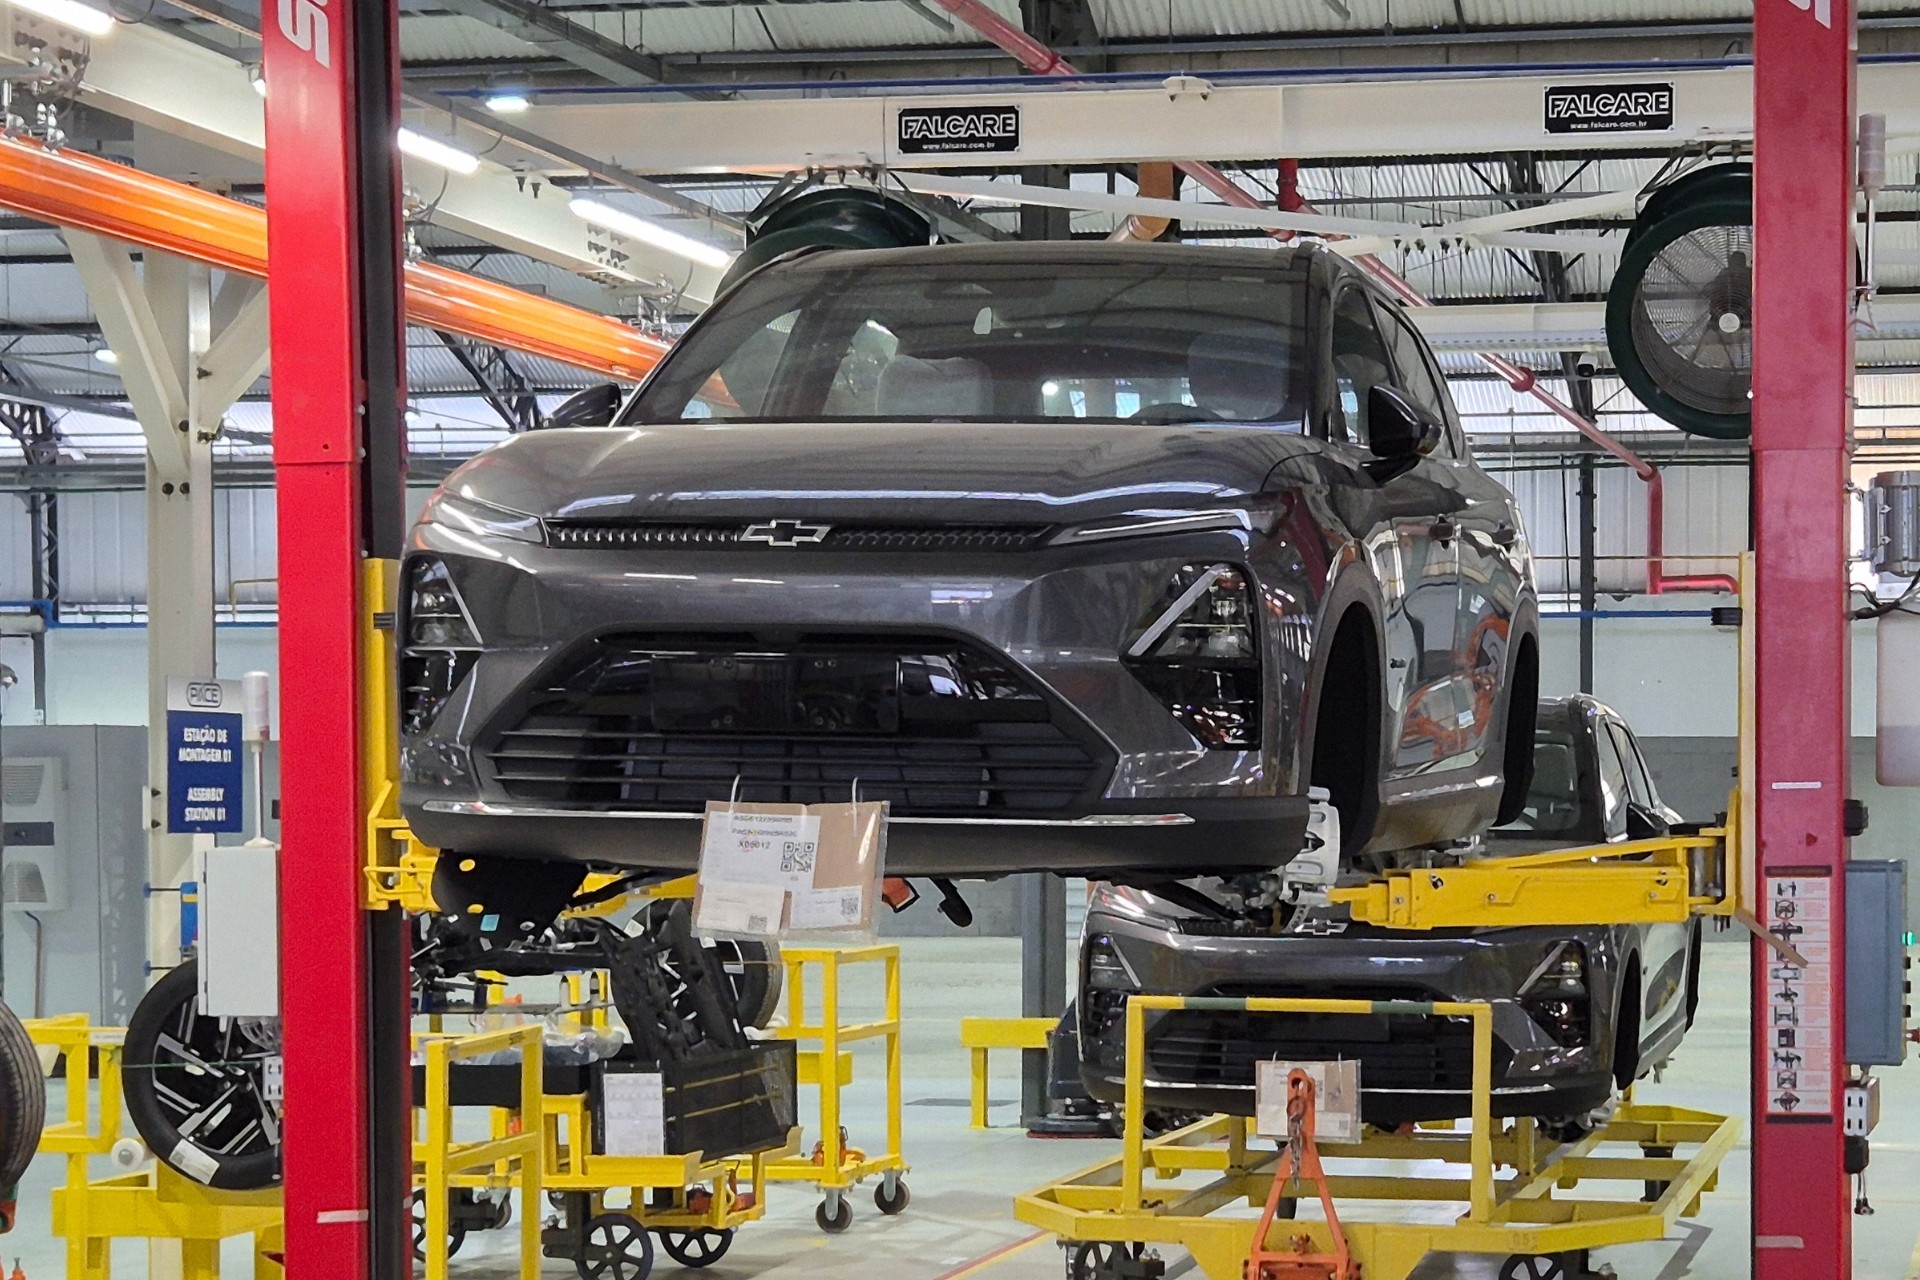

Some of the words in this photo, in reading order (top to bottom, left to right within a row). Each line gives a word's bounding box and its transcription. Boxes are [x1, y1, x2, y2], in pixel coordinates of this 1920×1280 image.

[1548, 91, 1670, 119] FALCARE
[901, 113, 1016, 139] FALCARE
[189, 686, 219, 704] PACE
[217, 728, 228, 743] DE
[187, 787, 224, 802] ASSEMBLY
[184, 807, 216, 822] STATION
[217, 807, 226, 822] 01
